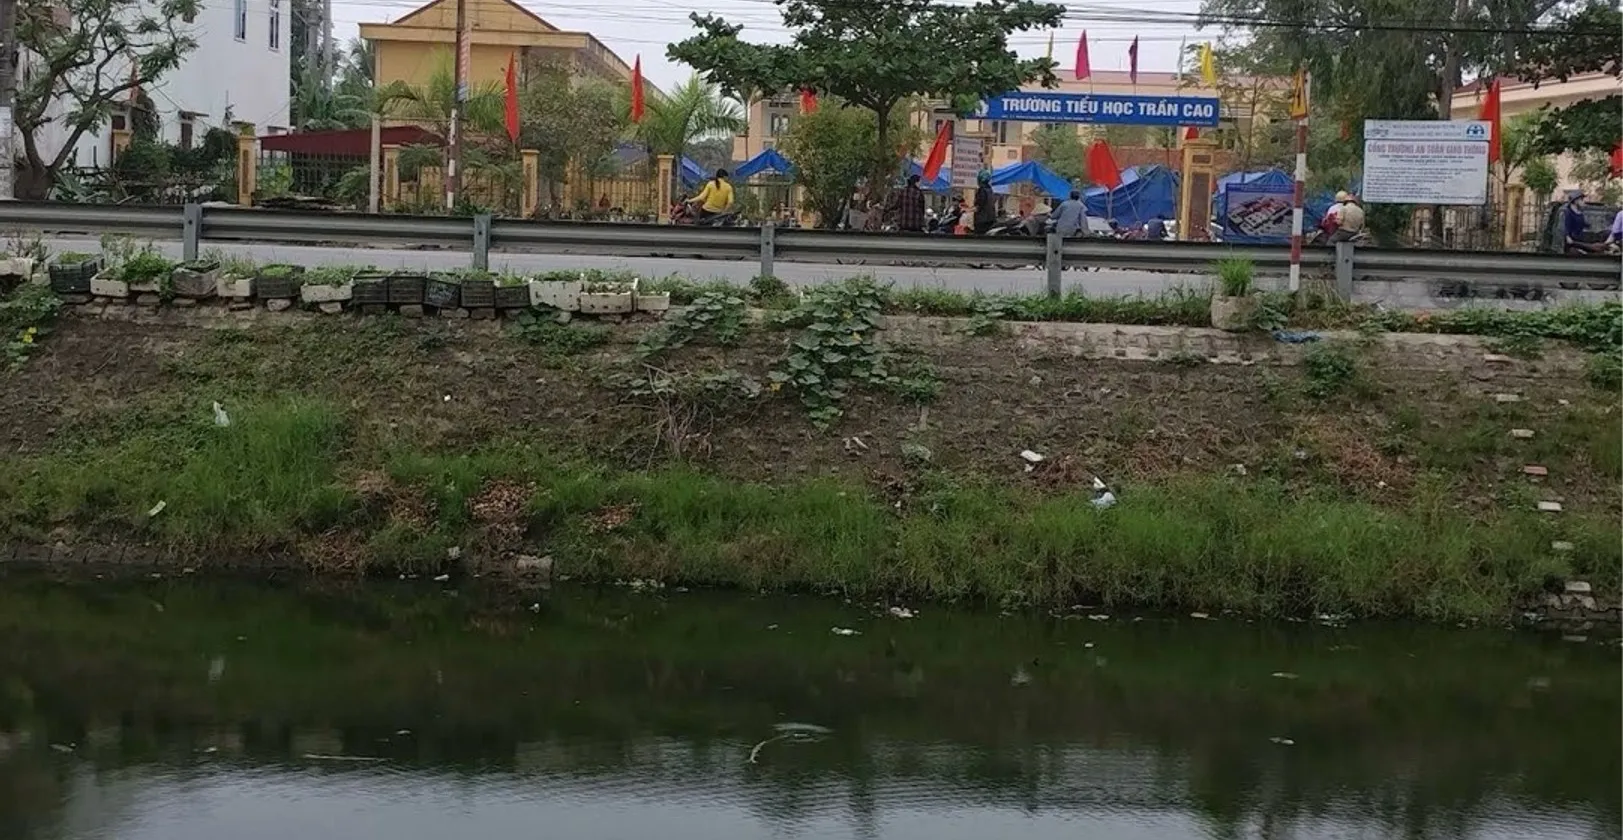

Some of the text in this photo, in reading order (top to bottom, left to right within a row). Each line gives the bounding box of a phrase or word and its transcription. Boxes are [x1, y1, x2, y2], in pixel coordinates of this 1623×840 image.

[1001, 96, 1213, 118] TRƯỜNG TIỂU HỌC TRẦN CAO
